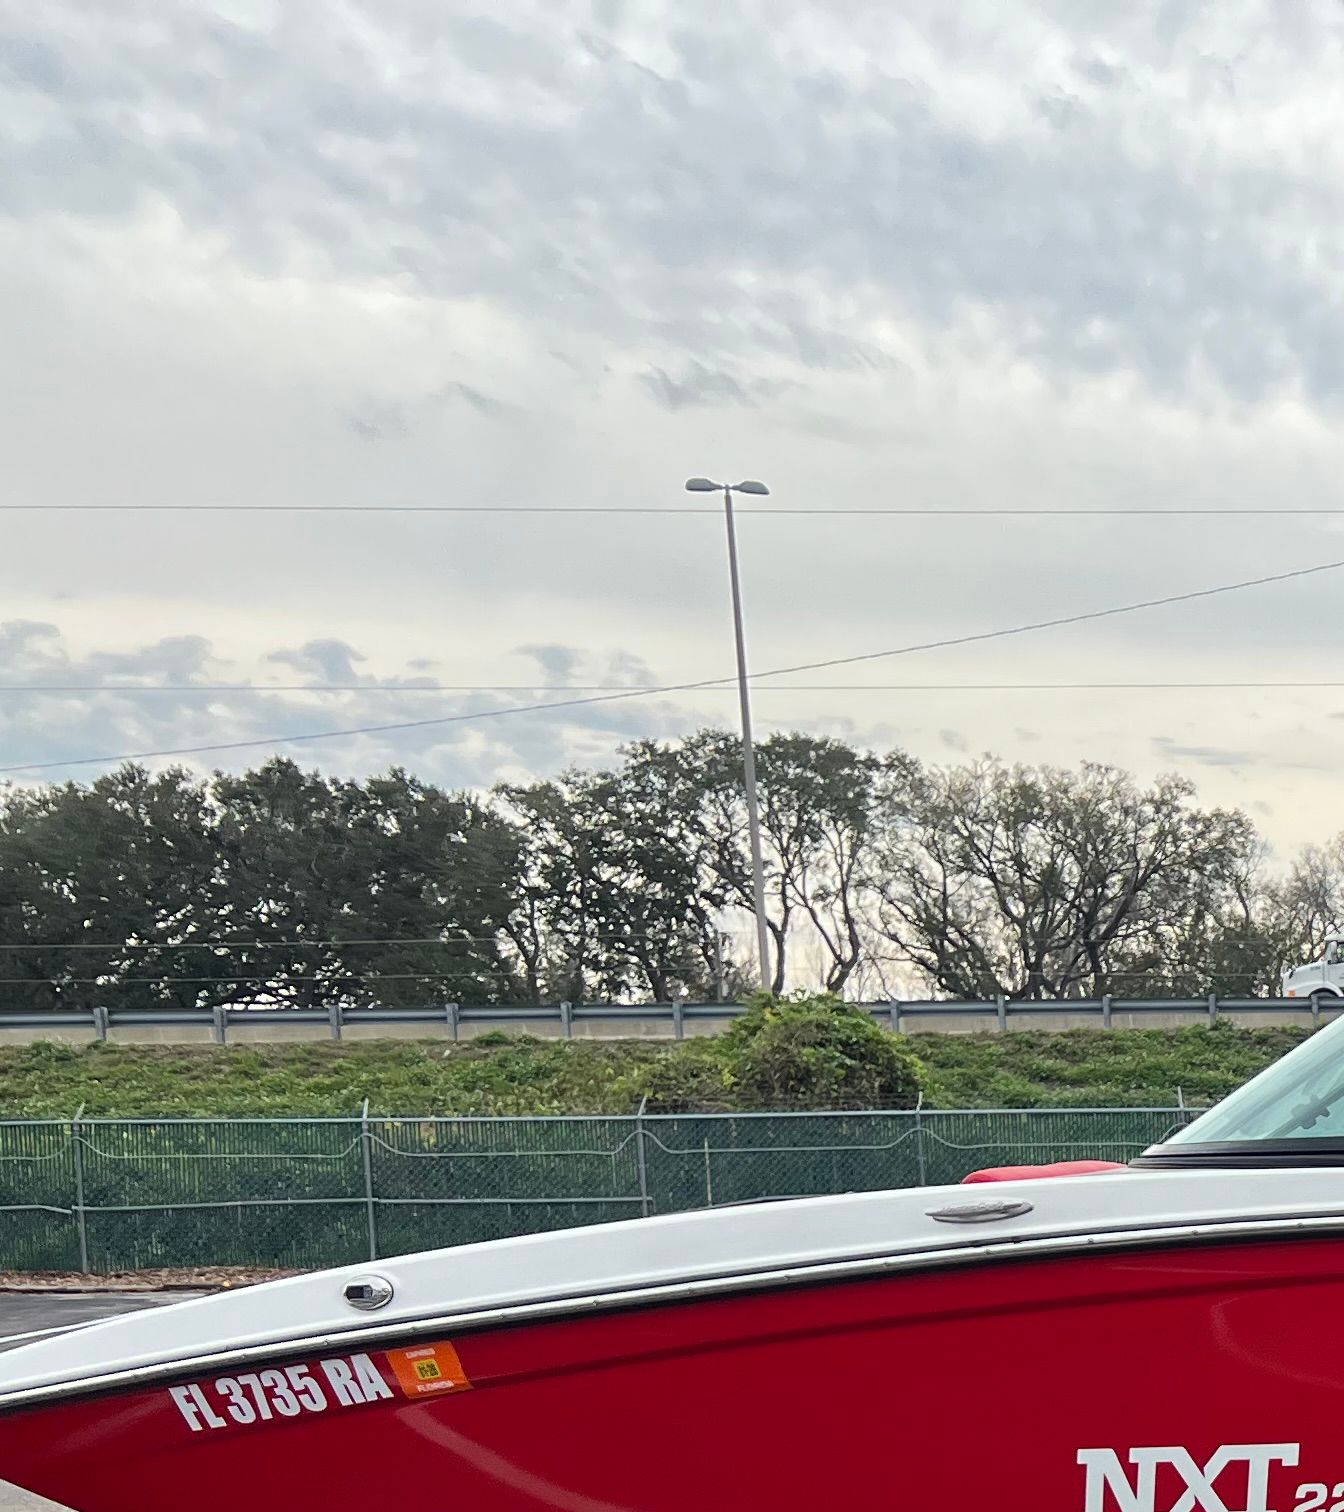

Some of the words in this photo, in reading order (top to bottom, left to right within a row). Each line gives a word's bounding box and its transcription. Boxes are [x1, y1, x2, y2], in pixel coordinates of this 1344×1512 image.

[168, 1383, 227, 1432] FL
[215, 1363, 328, 1424] 3735
[319, 1352, 394, 1407] RA
